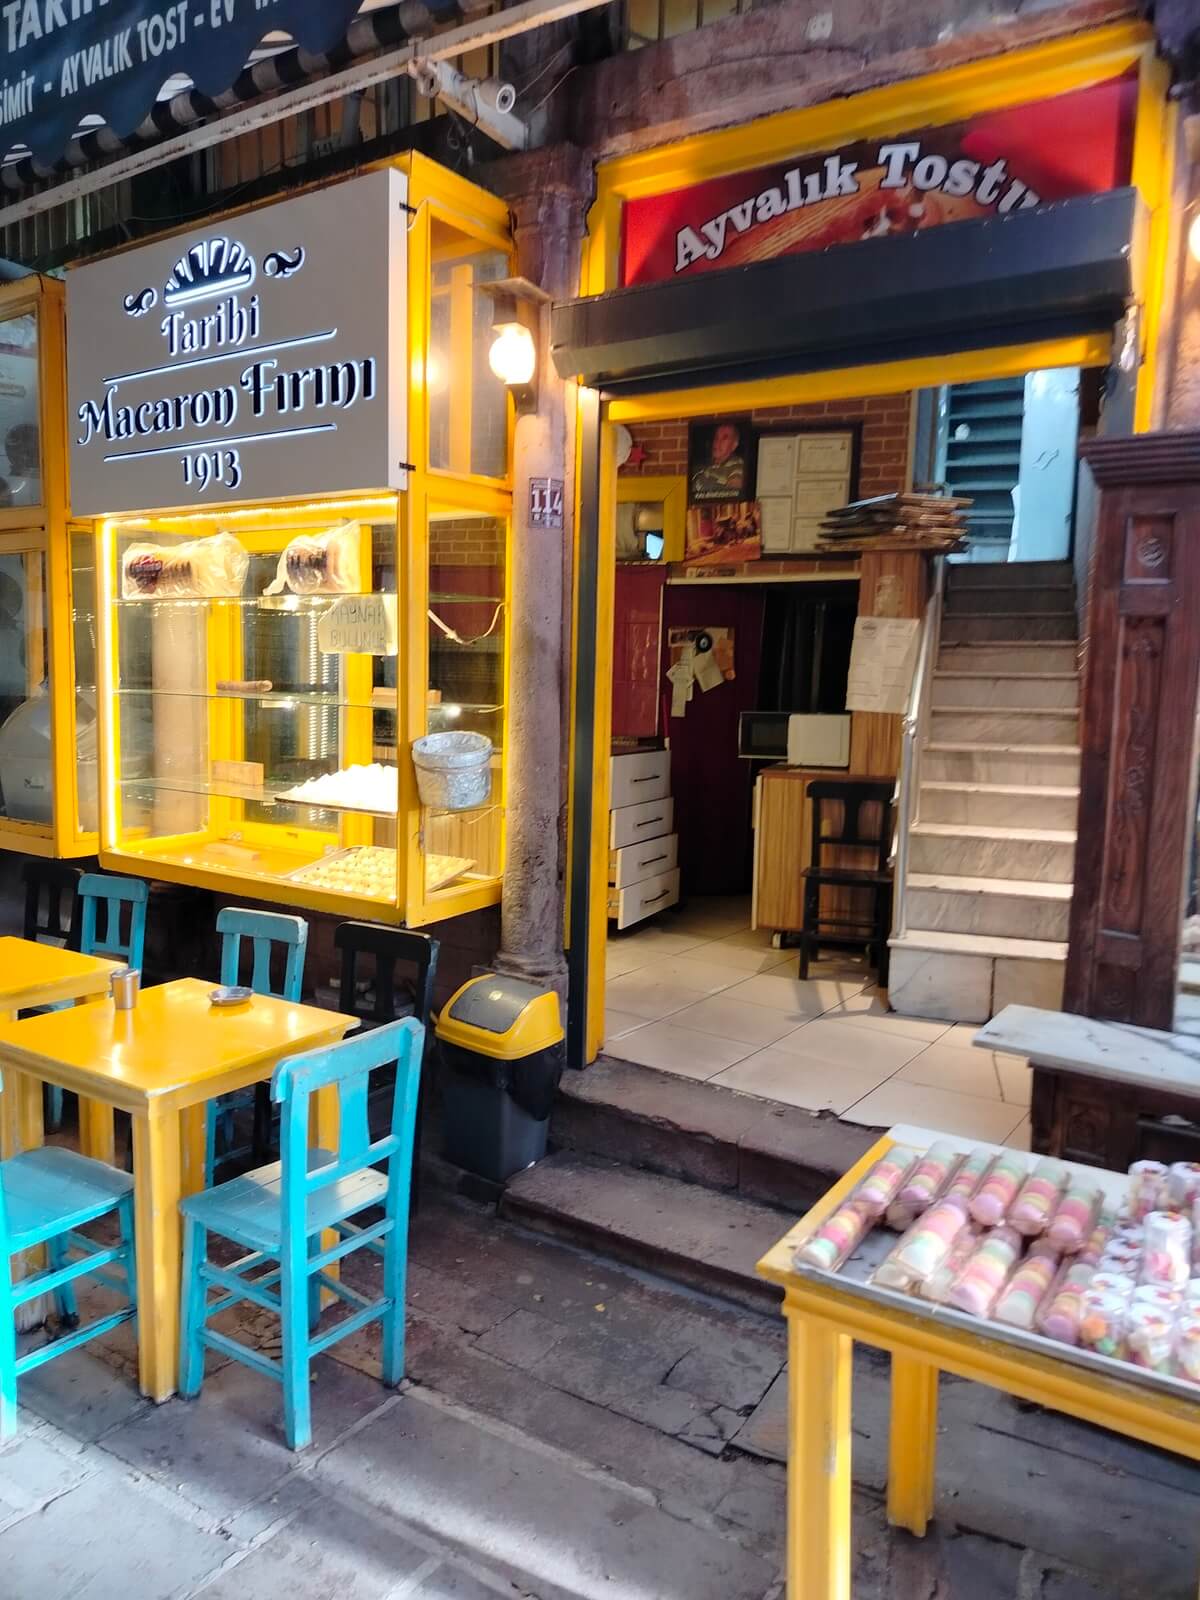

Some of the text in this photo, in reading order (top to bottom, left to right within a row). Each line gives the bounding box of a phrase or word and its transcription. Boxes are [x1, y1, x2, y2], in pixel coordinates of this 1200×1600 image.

[61, 26, 133, 98] AYVALIK
[137, 0, 188, 62] TOST
[674, 154, 861, 273] Ayvalık
[161, 294, 260, 356] Tarihi
[77, 356, 377, 445] Macaron Fırını
[181, 449, 242, 492] 1913
[531, 487, 563, 515] 114
